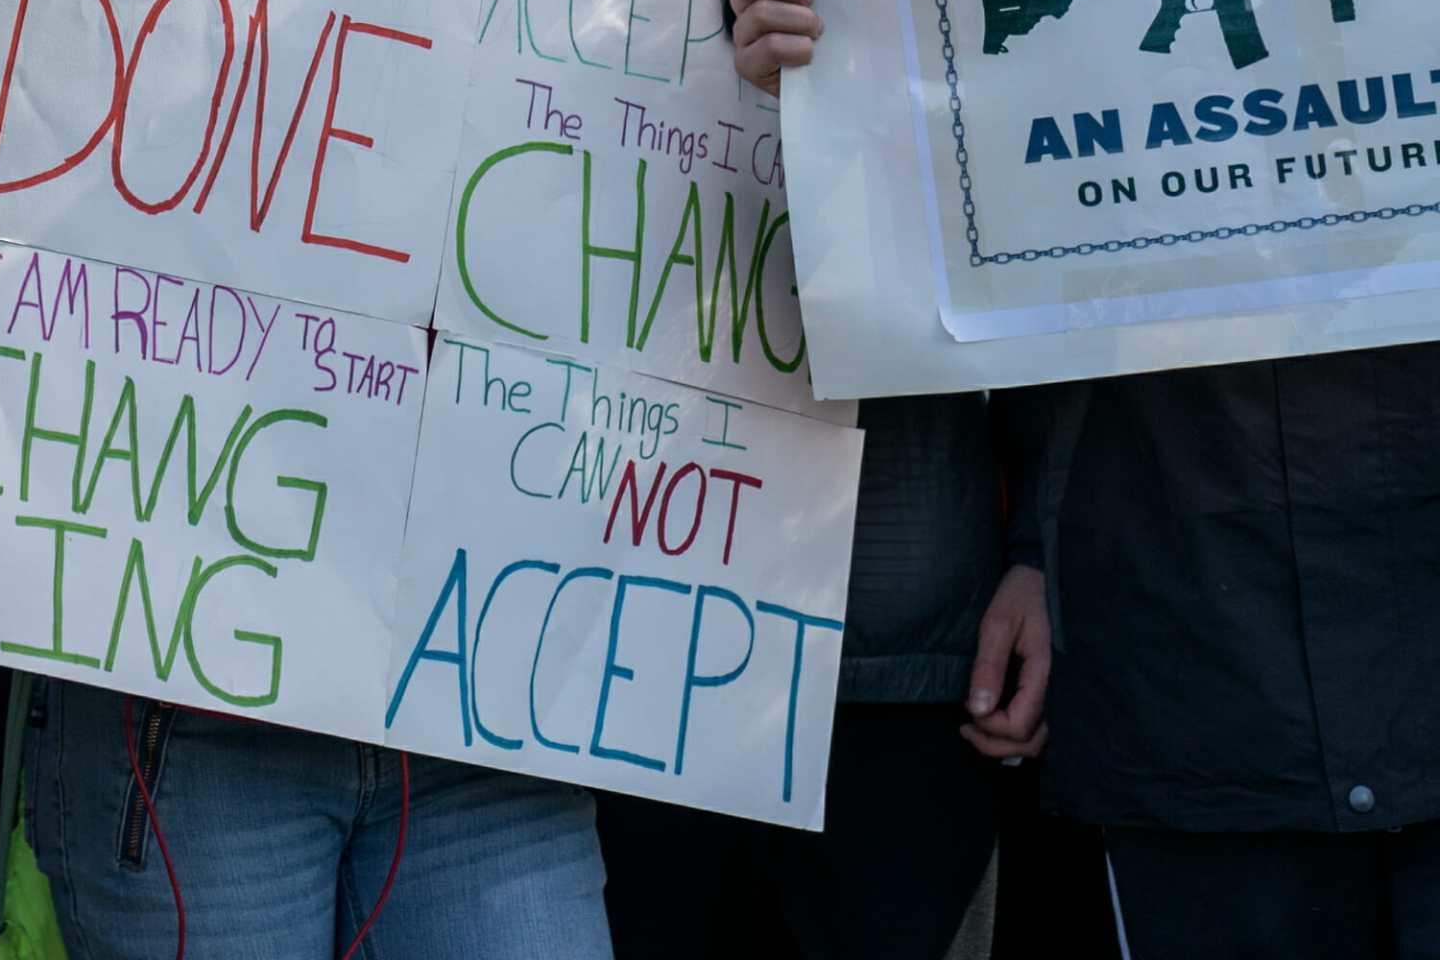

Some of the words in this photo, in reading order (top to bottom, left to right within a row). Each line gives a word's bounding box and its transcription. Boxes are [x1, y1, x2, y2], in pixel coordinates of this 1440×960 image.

[515, 77, 584, 140] The
[614, 96, 709, 174] Things
[711, 120, 745, 174] I
[751, 132, 785, 189] CA
[1024, 107, 1125, 164] AN
[1145, 68, 1440, 150] ASSAUL
[1077, 176, 1138, 207] ON
[1161, 162, 1254, 199] OUR
[8, 251, 90, 350] AM
[111, 265, 281, 381] READY
[295, 312, 337, 355] TO
[456, 140, 813, 385] CHANG
[312, 348, 420, 406] START
[443, 338, 533, 414] The
[545, 358, 681, 460] Things
[701, 395, 748, 451] I
[0, 514, 283, 708] ING
[384, 547, 844, 803] ACCEPT
